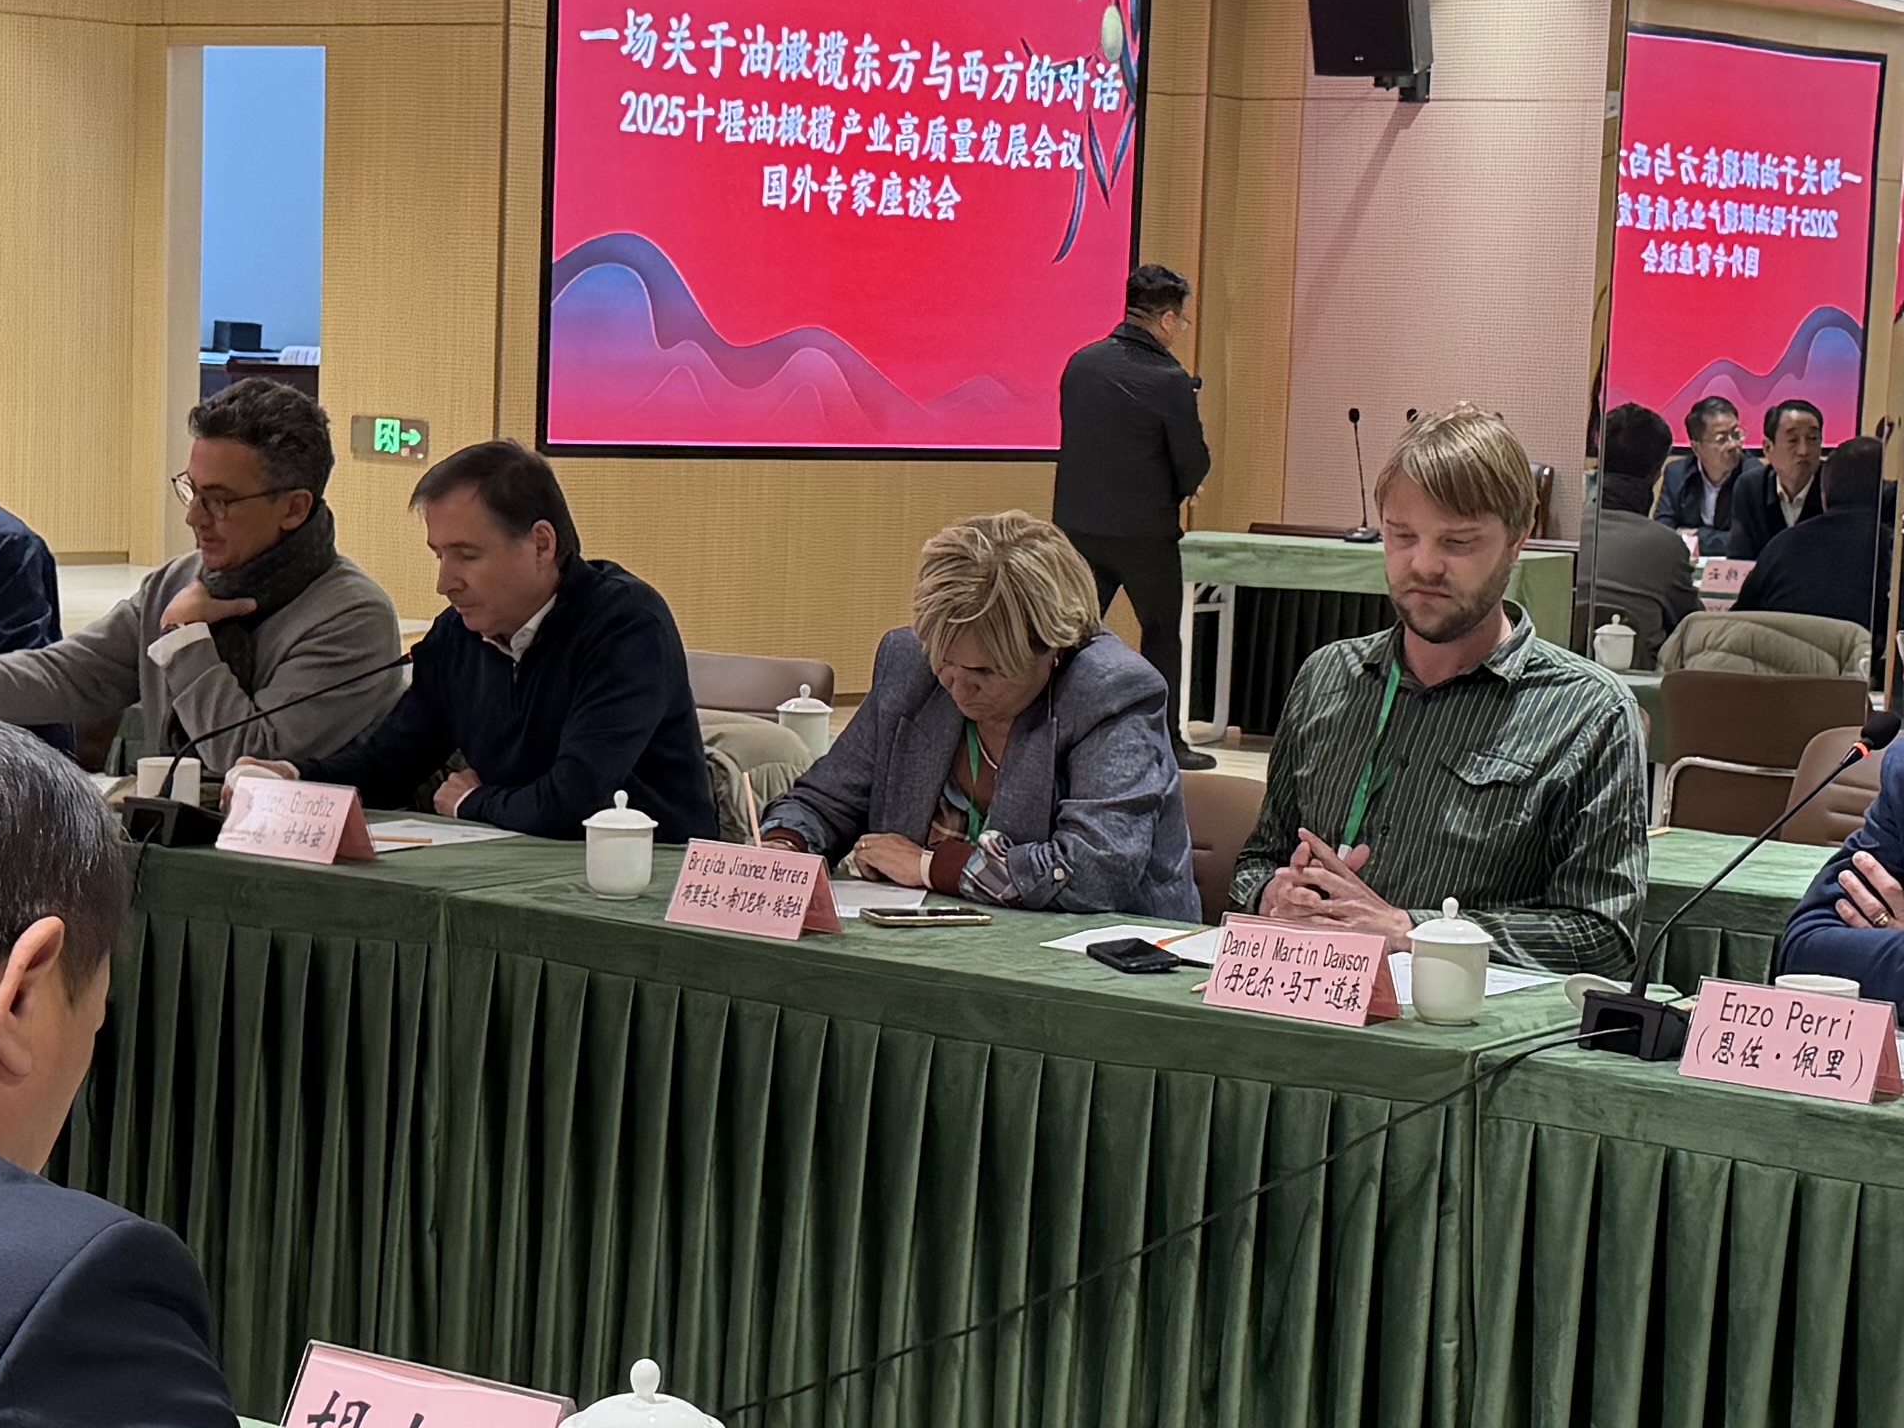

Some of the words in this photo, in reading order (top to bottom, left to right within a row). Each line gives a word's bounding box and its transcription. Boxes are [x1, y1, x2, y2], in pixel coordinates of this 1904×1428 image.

[579, 8, 1123, 113] 一场关于油橄榄东方与西方的对话
[619, 90, 1085, 170] 2025十堰油橄榄产业高质量发展会议
[762, 163, 962, 221] 国外专家座谈会
[769, 859, 809, 885] Herrera
[1222, 930, 1268, 960] Daniel
[1272, 936, 1318, 966] Martin
[1323, 943, 1370, 973] Dawson
[1719, 991, 1774, 1028] Enzo
[1786, 1001, 1855, 1040] Perri
